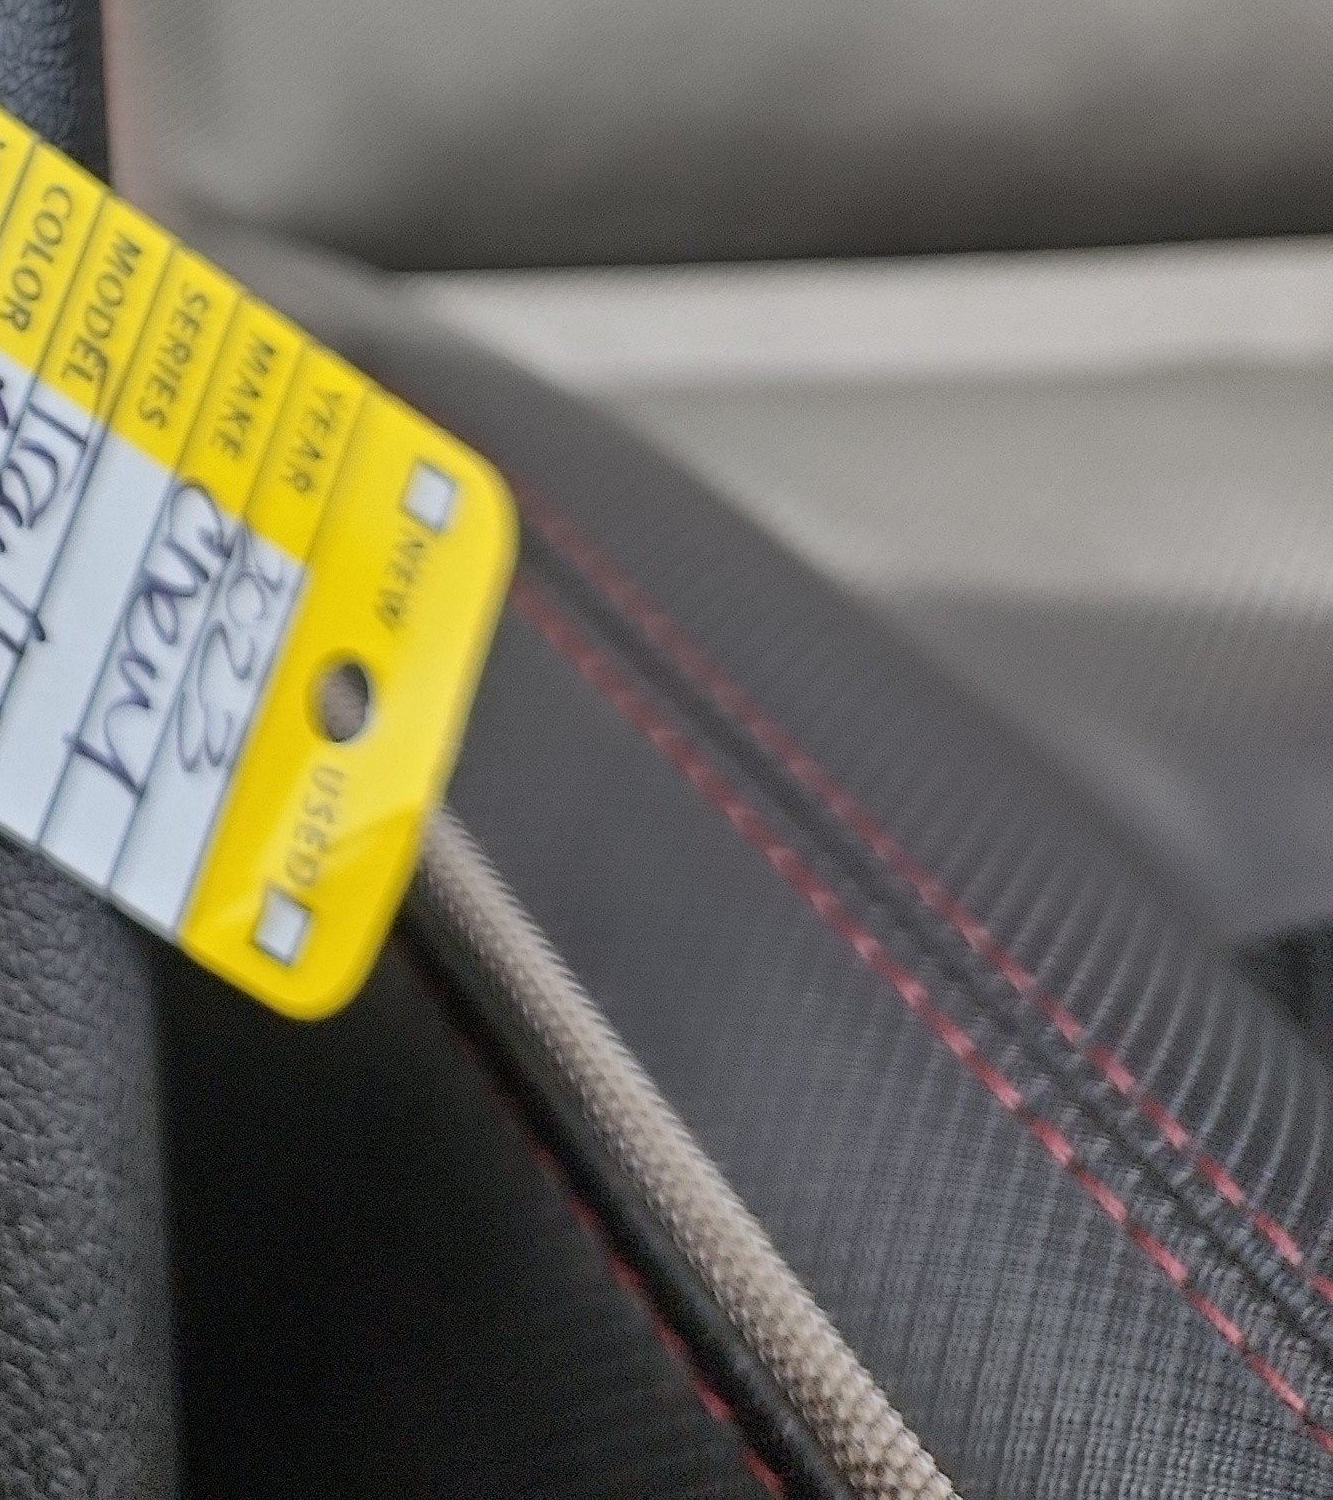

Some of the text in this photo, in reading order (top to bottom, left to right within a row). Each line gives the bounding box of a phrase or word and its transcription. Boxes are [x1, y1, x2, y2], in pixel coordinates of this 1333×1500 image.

[60, 230, 143, 385] MODEL
[139, 283, 210, 430] SERIES
[213, 330, 276, 461] MAKE
[284, 387, 344, 494] YEAR
[289, 526, 432, 892] NEW USED
